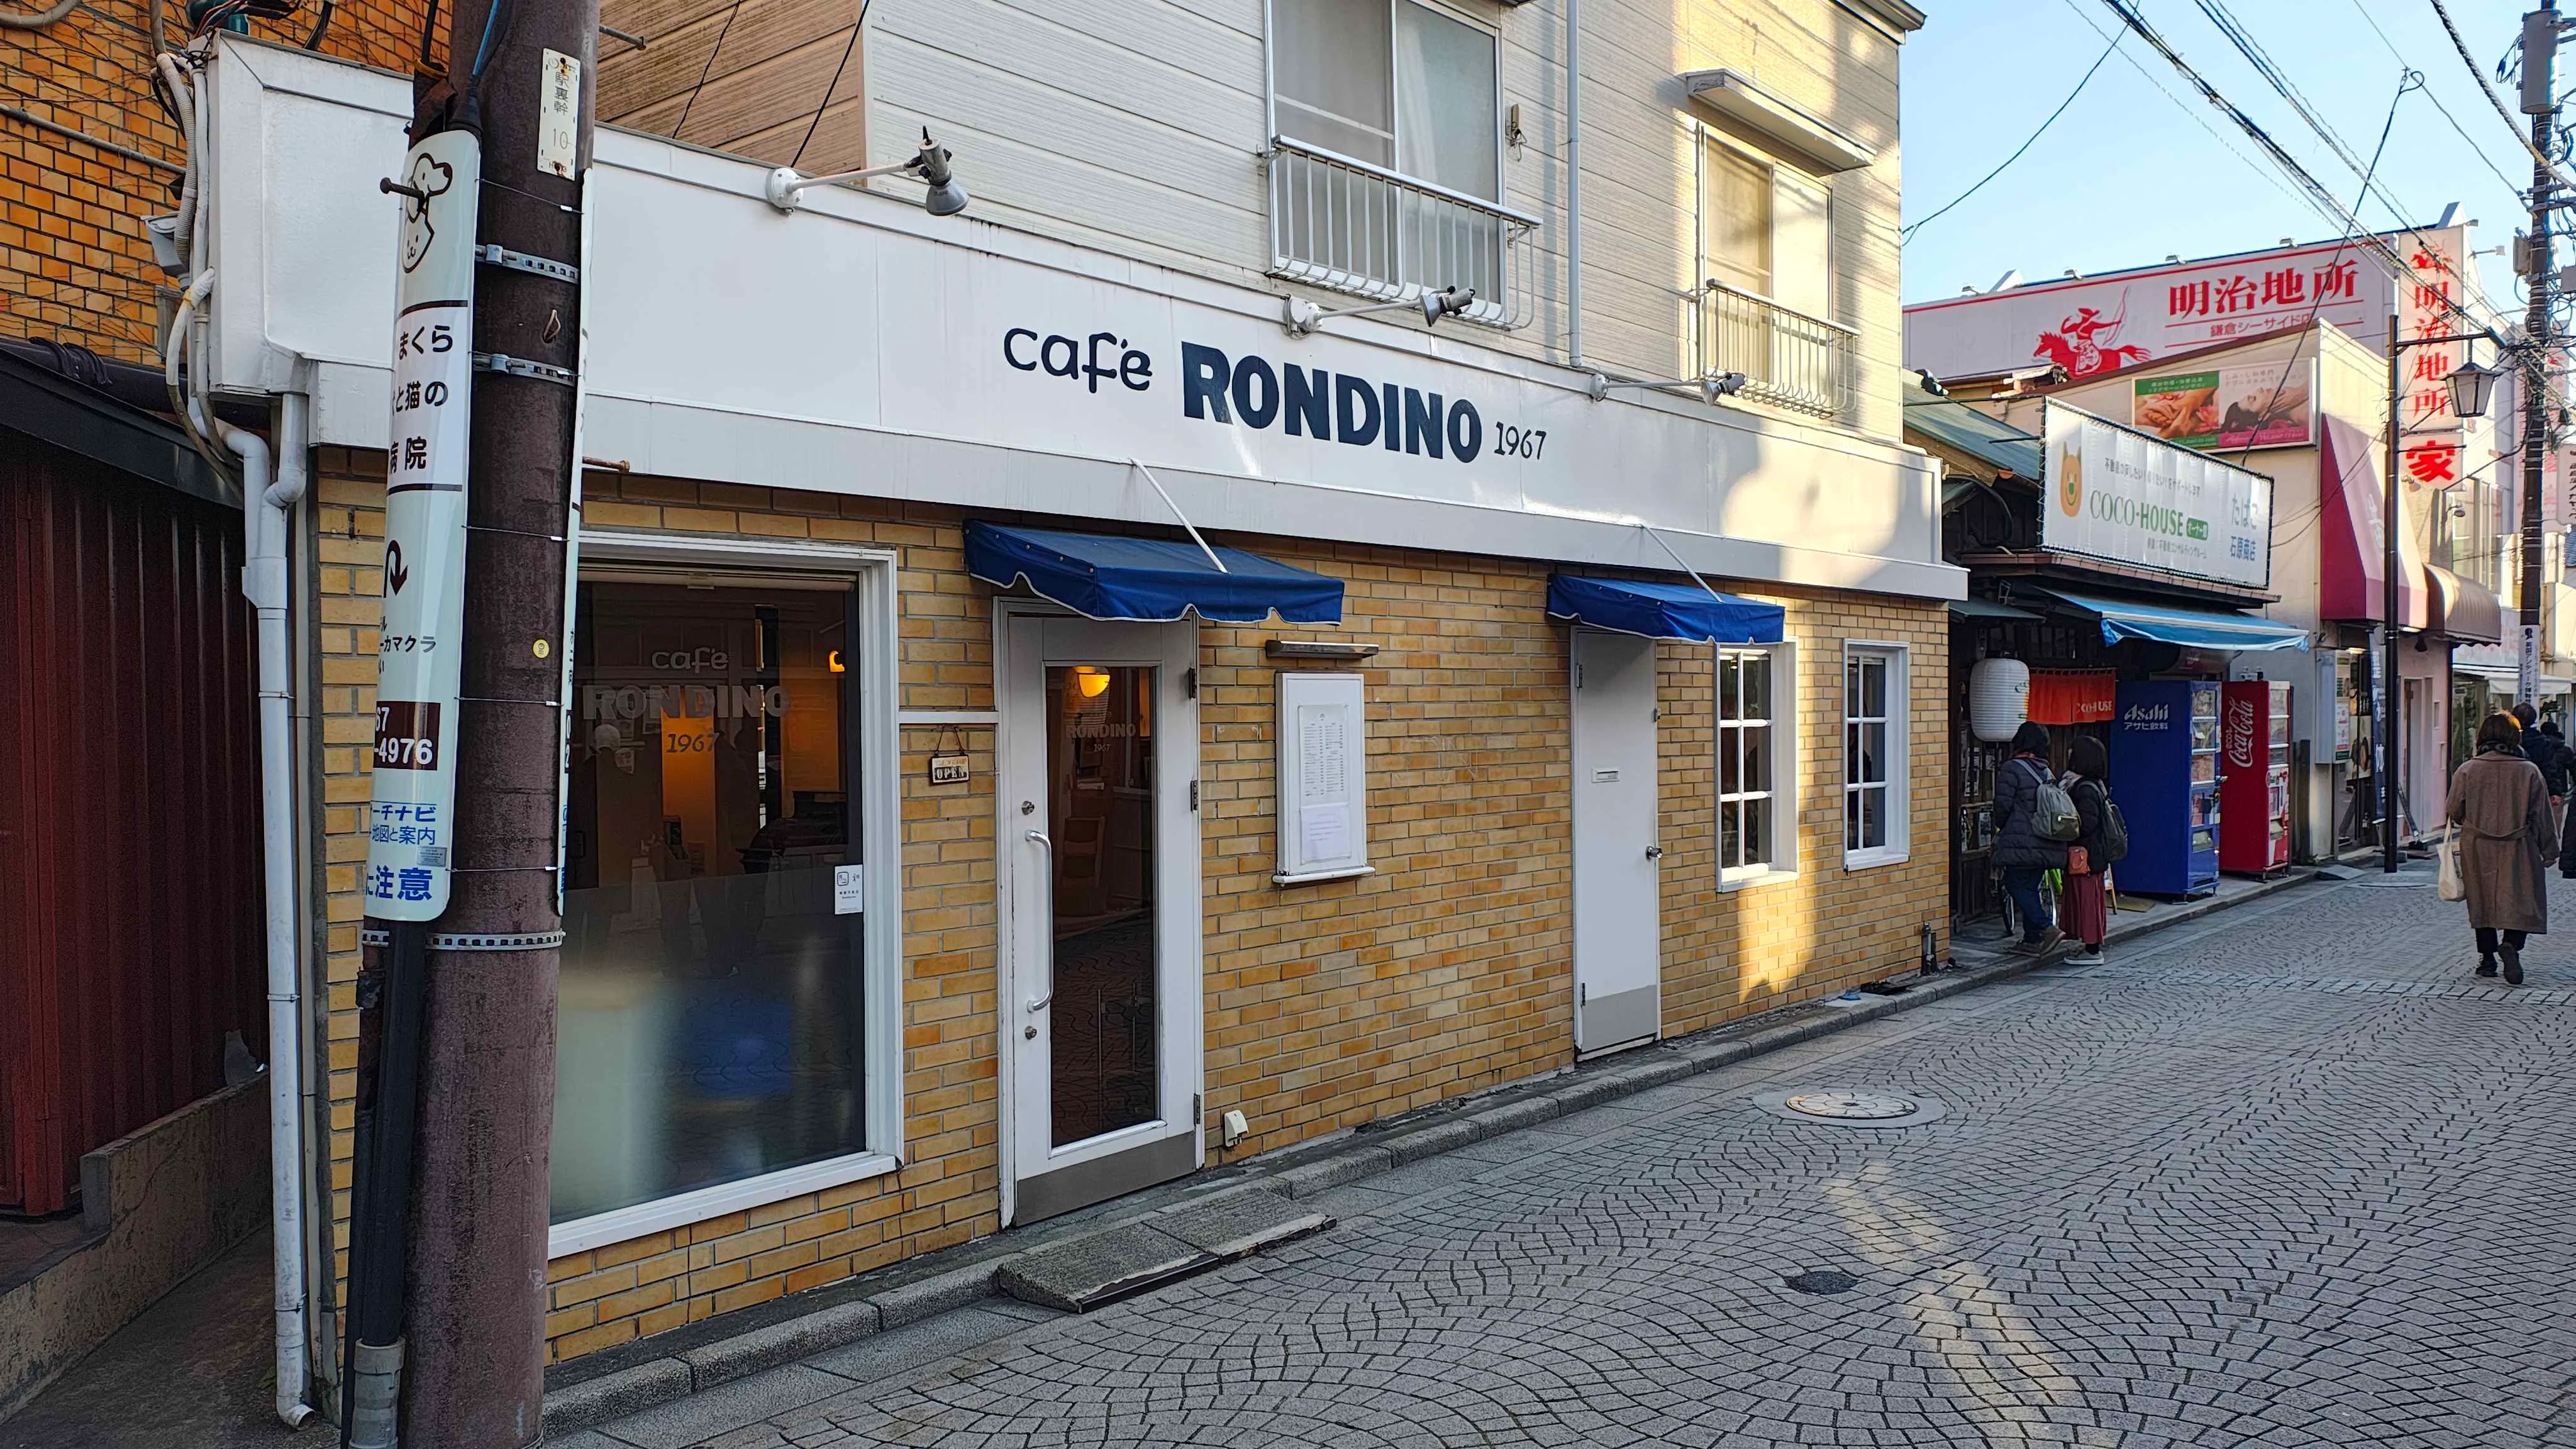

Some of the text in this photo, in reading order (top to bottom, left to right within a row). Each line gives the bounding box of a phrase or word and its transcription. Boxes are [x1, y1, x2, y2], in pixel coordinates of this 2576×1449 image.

[2169, 258, 2359, 319] 明治地所
[392, 381, 449, 416] と猫の
[1004, 327, 1547, 464] café RONDINO 1967
[2406, 440, 2456, 483] 家
[2231, 493, 2259, 530] たばこ
[582, 684, 791, 720] RONDINO
[2124, 704, 2168, 721] Asahi
[665, 733, 719, 753] 1967
[936, 766, 965, 780] OPEN
